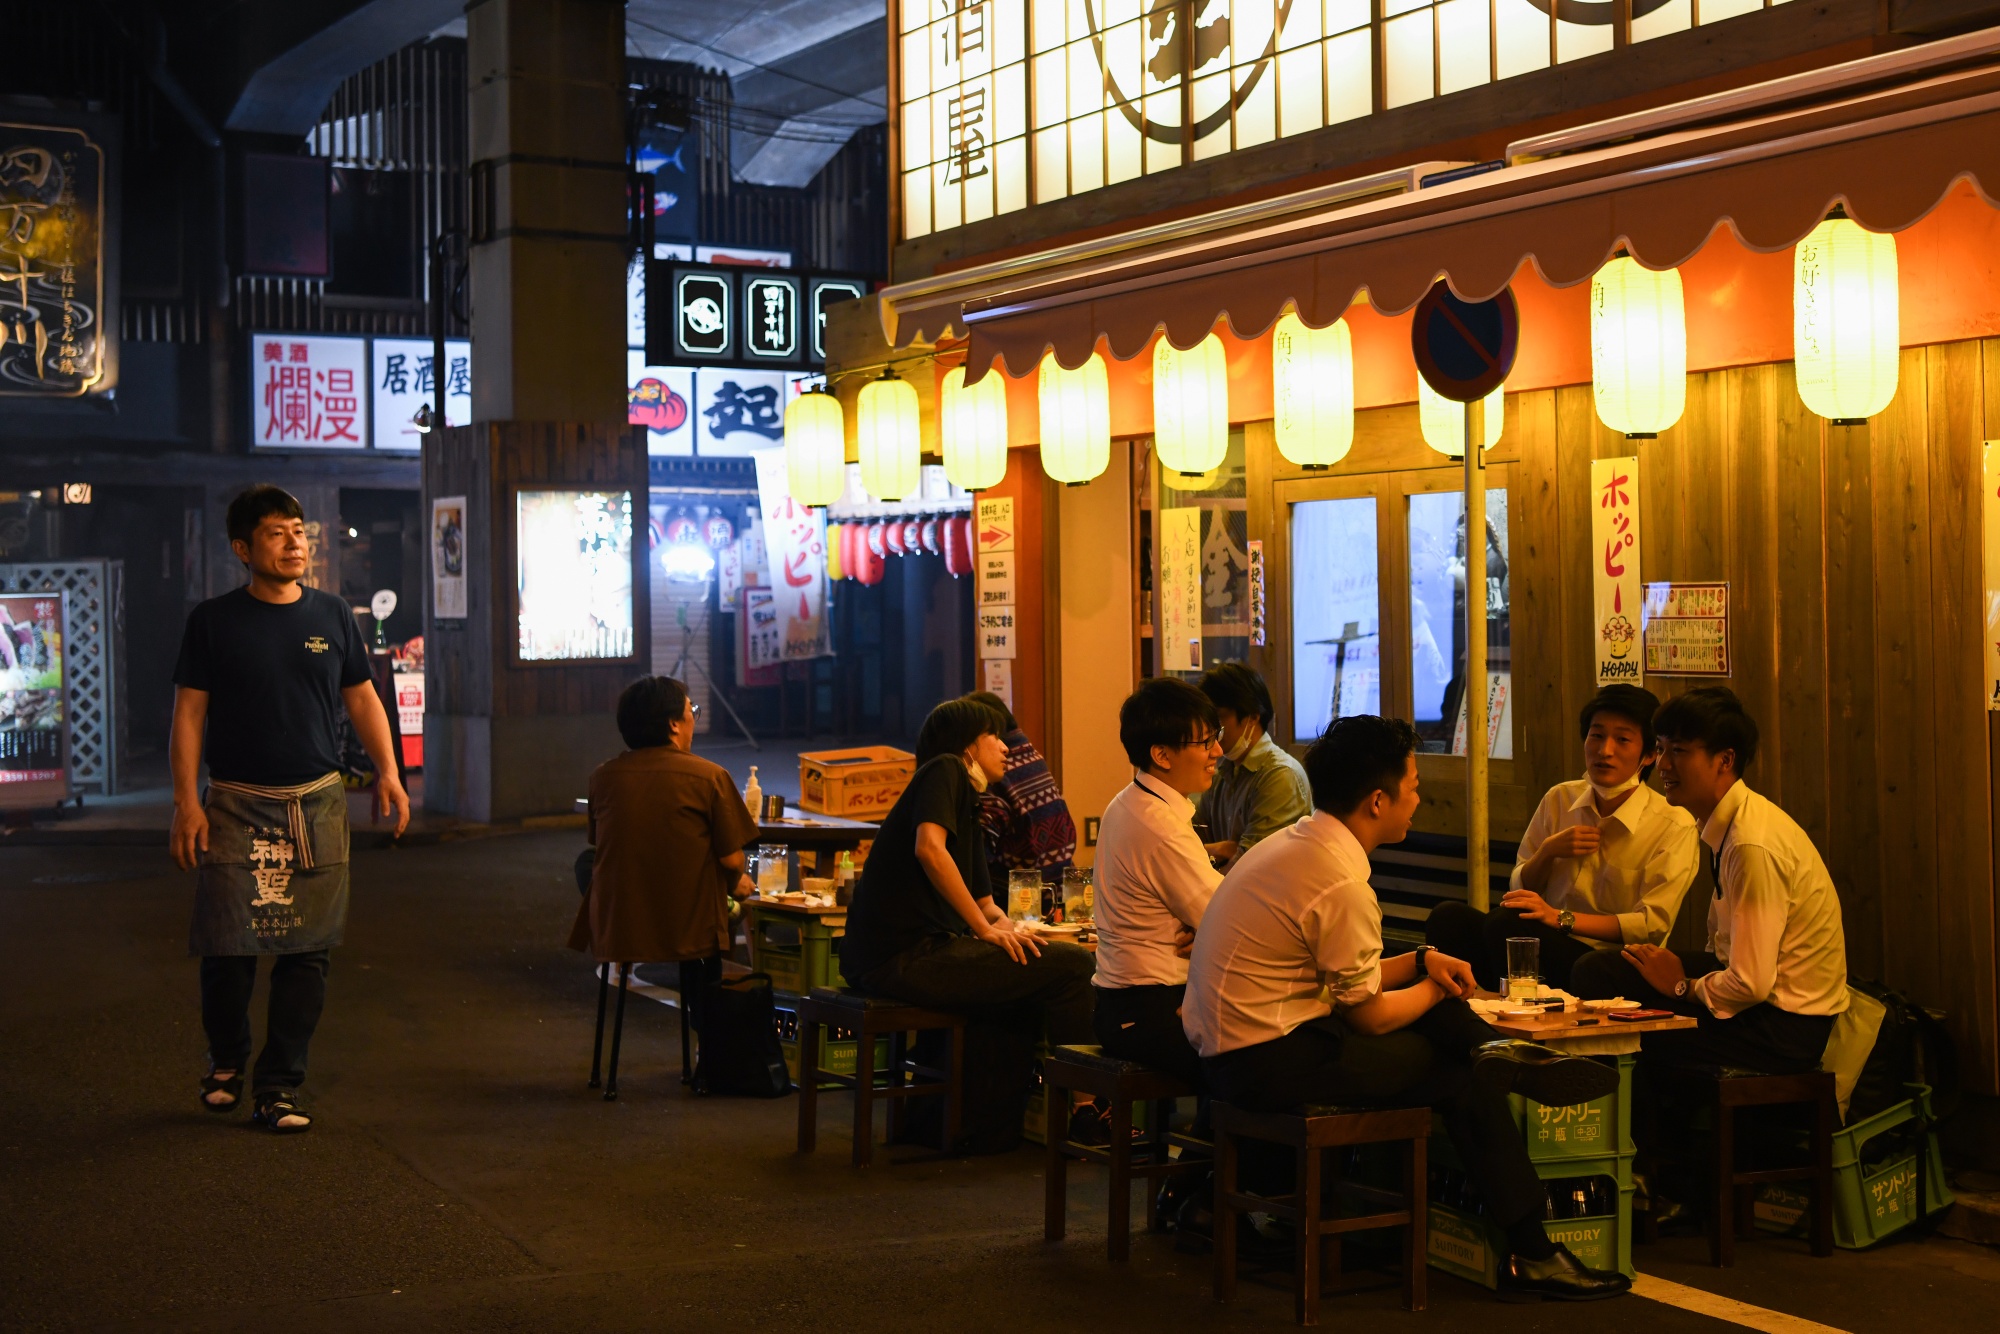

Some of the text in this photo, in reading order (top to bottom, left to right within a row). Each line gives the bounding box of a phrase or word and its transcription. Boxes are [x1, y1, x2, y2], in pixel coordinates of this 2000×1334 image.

[382, 353, 471, 396] 居酒屋
[264, 365, 359, 443] 爛漫
[1602, 465, 1634, 615] ホッピー
[1185, 514, 1197, 629] 入店する前に
[1161, 545, 1172, 657] お願いします
[848, 788, 901, 807] ホッピー
[249, 838, 295, 907] 神聖
[1537, 1102, 1601, 1125] サントリー
[1871, 1168, 1917, 1203] サントリー
[1546, 1228, 1601, 1244] UNTORY
